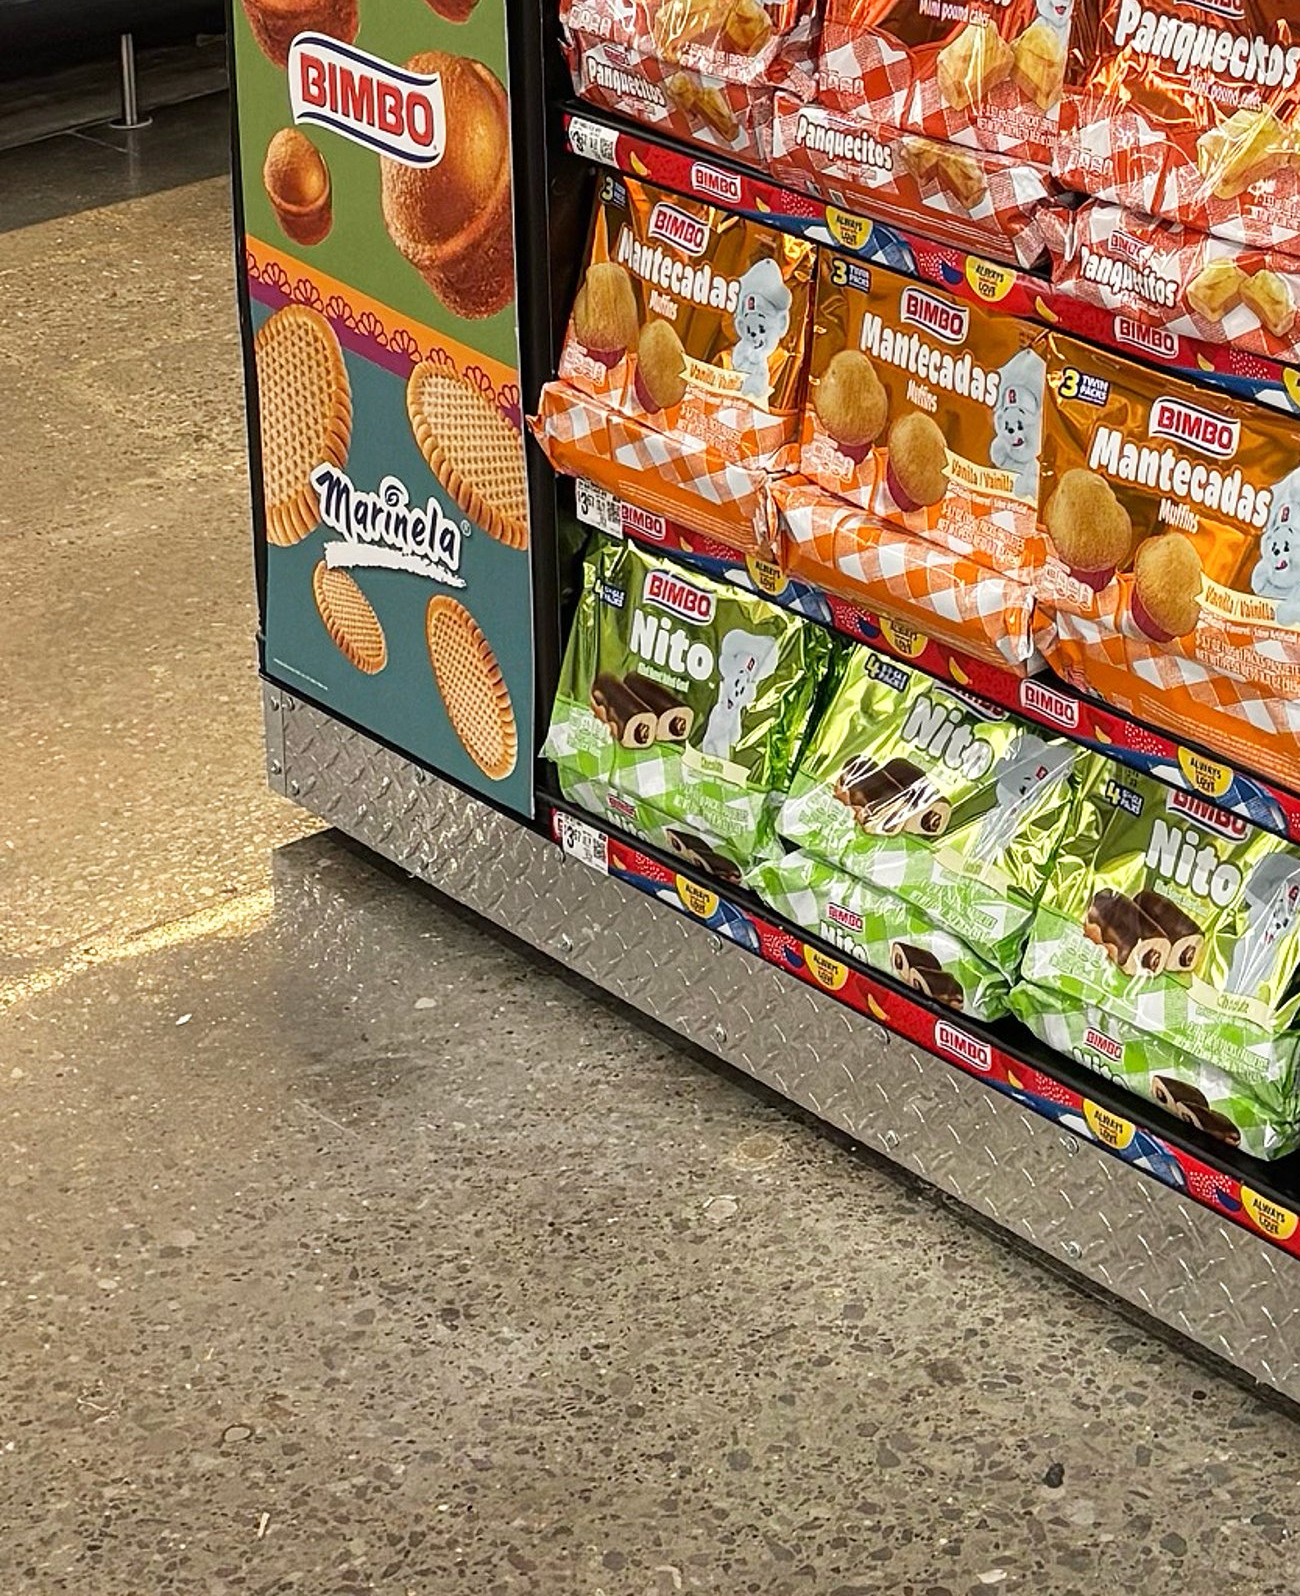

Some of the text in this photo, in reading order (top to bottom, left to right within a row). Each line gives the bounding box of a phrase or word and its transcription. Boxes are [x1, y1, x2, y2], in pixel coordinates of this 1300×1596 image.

[300, 52, 434, 146] BIMBO
[796, 114, 893, 172] Panquecitos
[655, 211, 704, 249] BIMBO
[618, 230, 740, 312] Mantecadas
[906, 296, 964, 335] BIMBO
[861, 314, 1000, 407] Mantecadas
[1060, 369, 1079, 396] 3
[1083, 374, 1110, 391] TWIN
[1080, 385, 1107, 402] PACKS
[1158, 406, 1234, 450] BIMBO
[1089, 427, 1273, 529] Mantecadas
[319, 471, 459, 563] Marinela
[1159, 498, 1199, 534] Muffins
[648, 575, 712, 618] BIMBO
[630, 610, 714, 680] Nito
[901, 697, 994, 781] Nito
[1146, 819, 1242, 906] Nito
[940, 1025, 988, 1065] BIMBO
